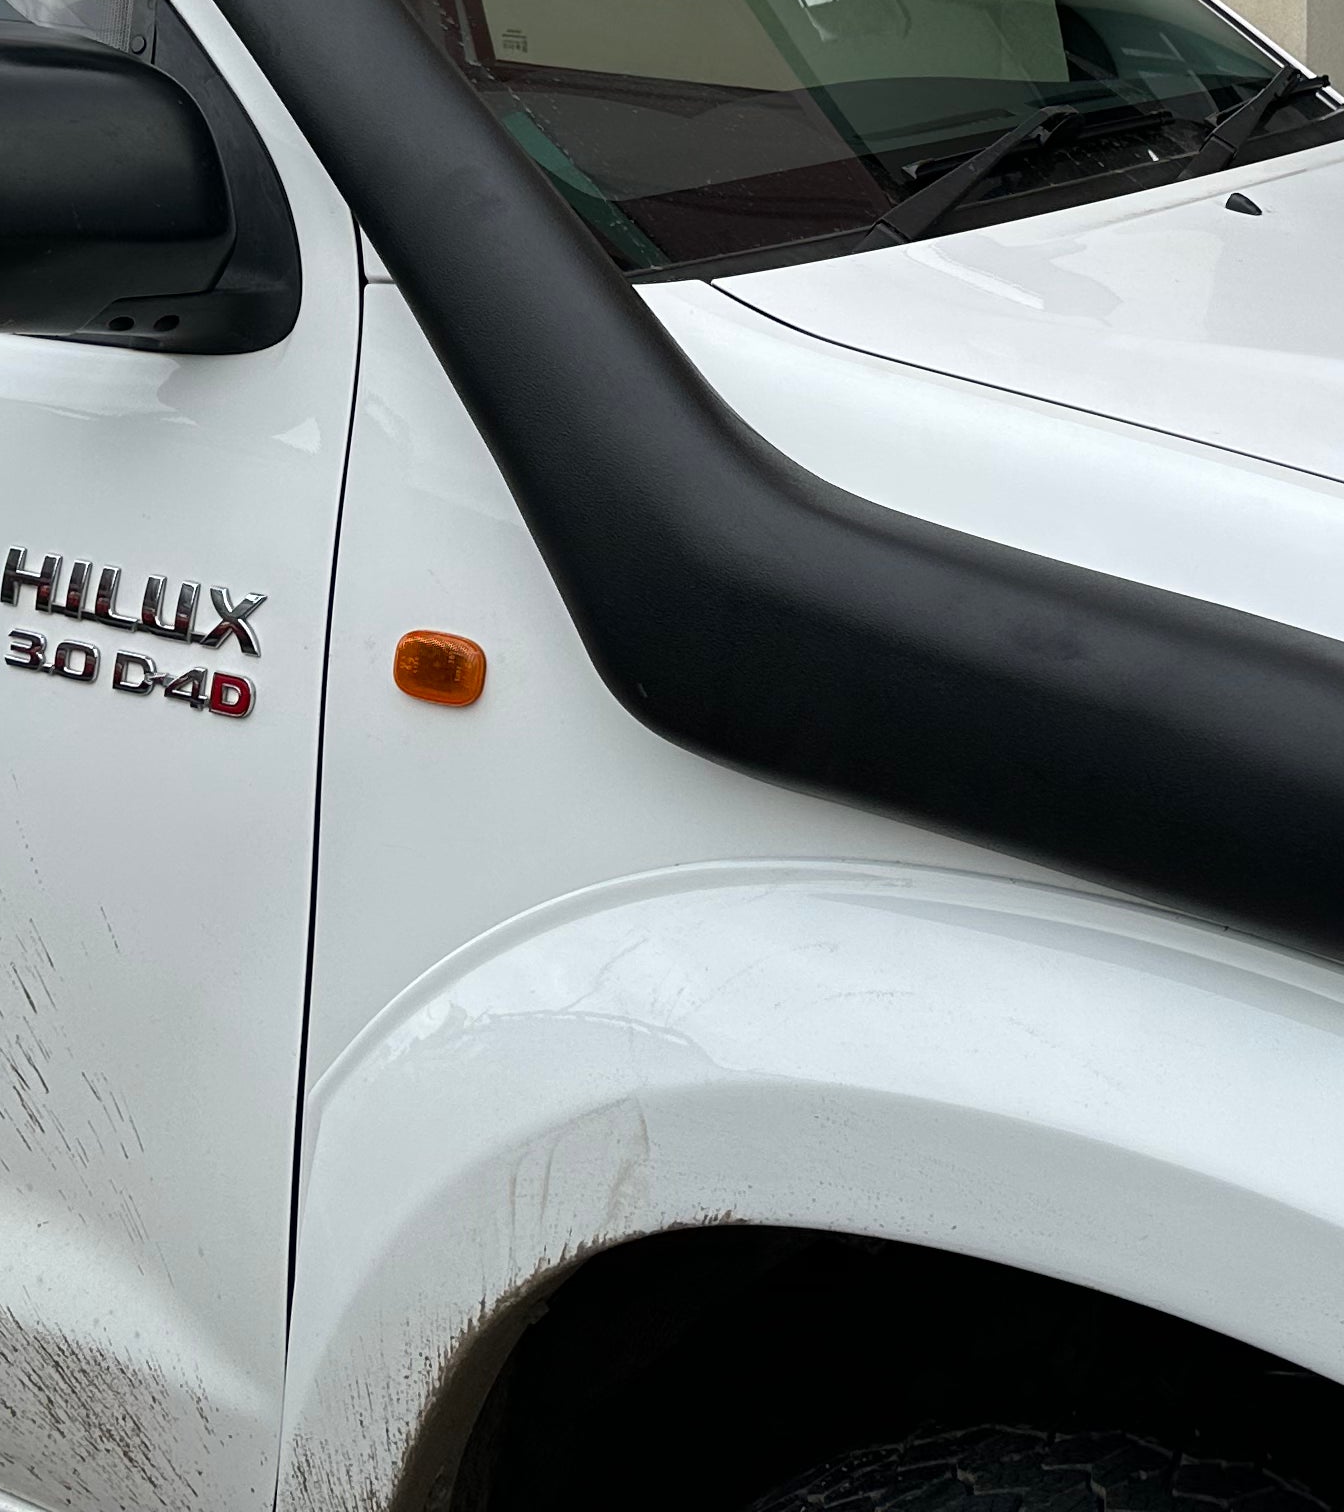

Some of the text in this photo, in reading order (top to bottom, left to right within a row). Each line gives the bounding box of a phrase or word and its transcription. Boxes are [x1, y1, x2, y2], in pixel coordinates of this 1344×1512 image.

[0, 545, 268, 657] HILUX
[4, 628, 257, 719] 3.0 D-4D
